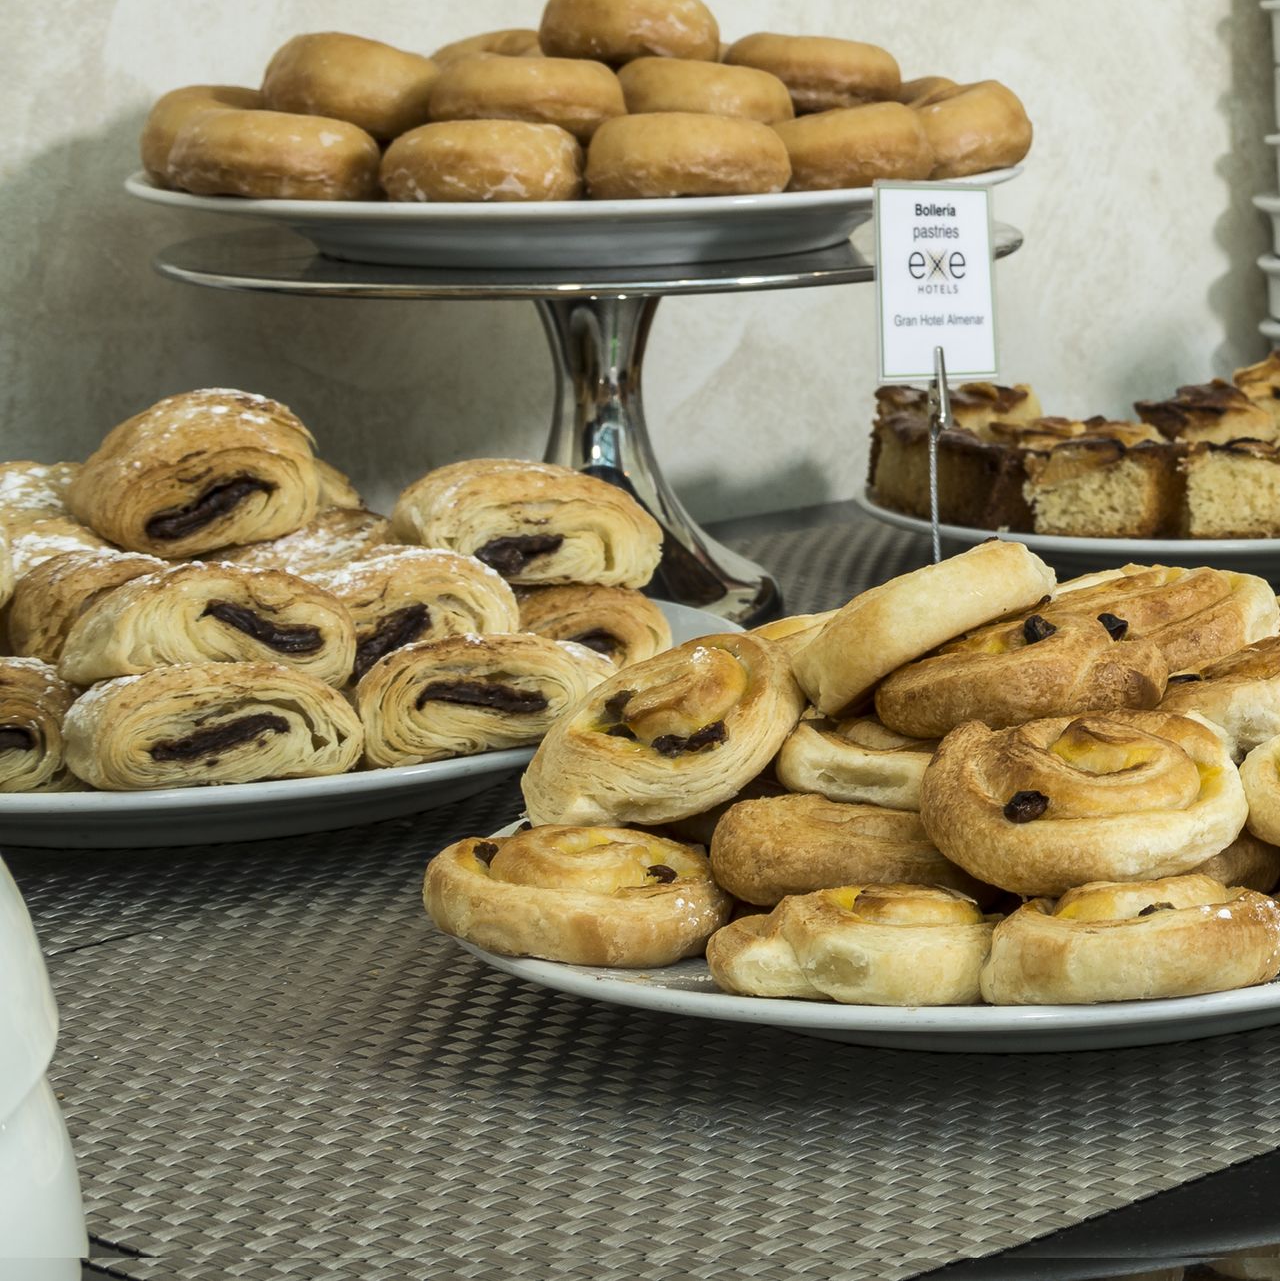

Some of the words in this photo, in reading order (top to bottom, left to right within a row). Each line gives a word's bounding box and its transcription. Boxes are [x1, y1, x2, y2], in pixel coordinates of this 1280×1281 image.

[915, 203, 956, 217] Bollería
[913, 225, 960, 242] pastries
[908, 249, 966, 281] exe
[917, 284, 959, 294] HOTELS
[894, 314, 917, 327] Gran
[920, 314, 944, 326] Hotel
[946, 313, 984, 326] Almenar
